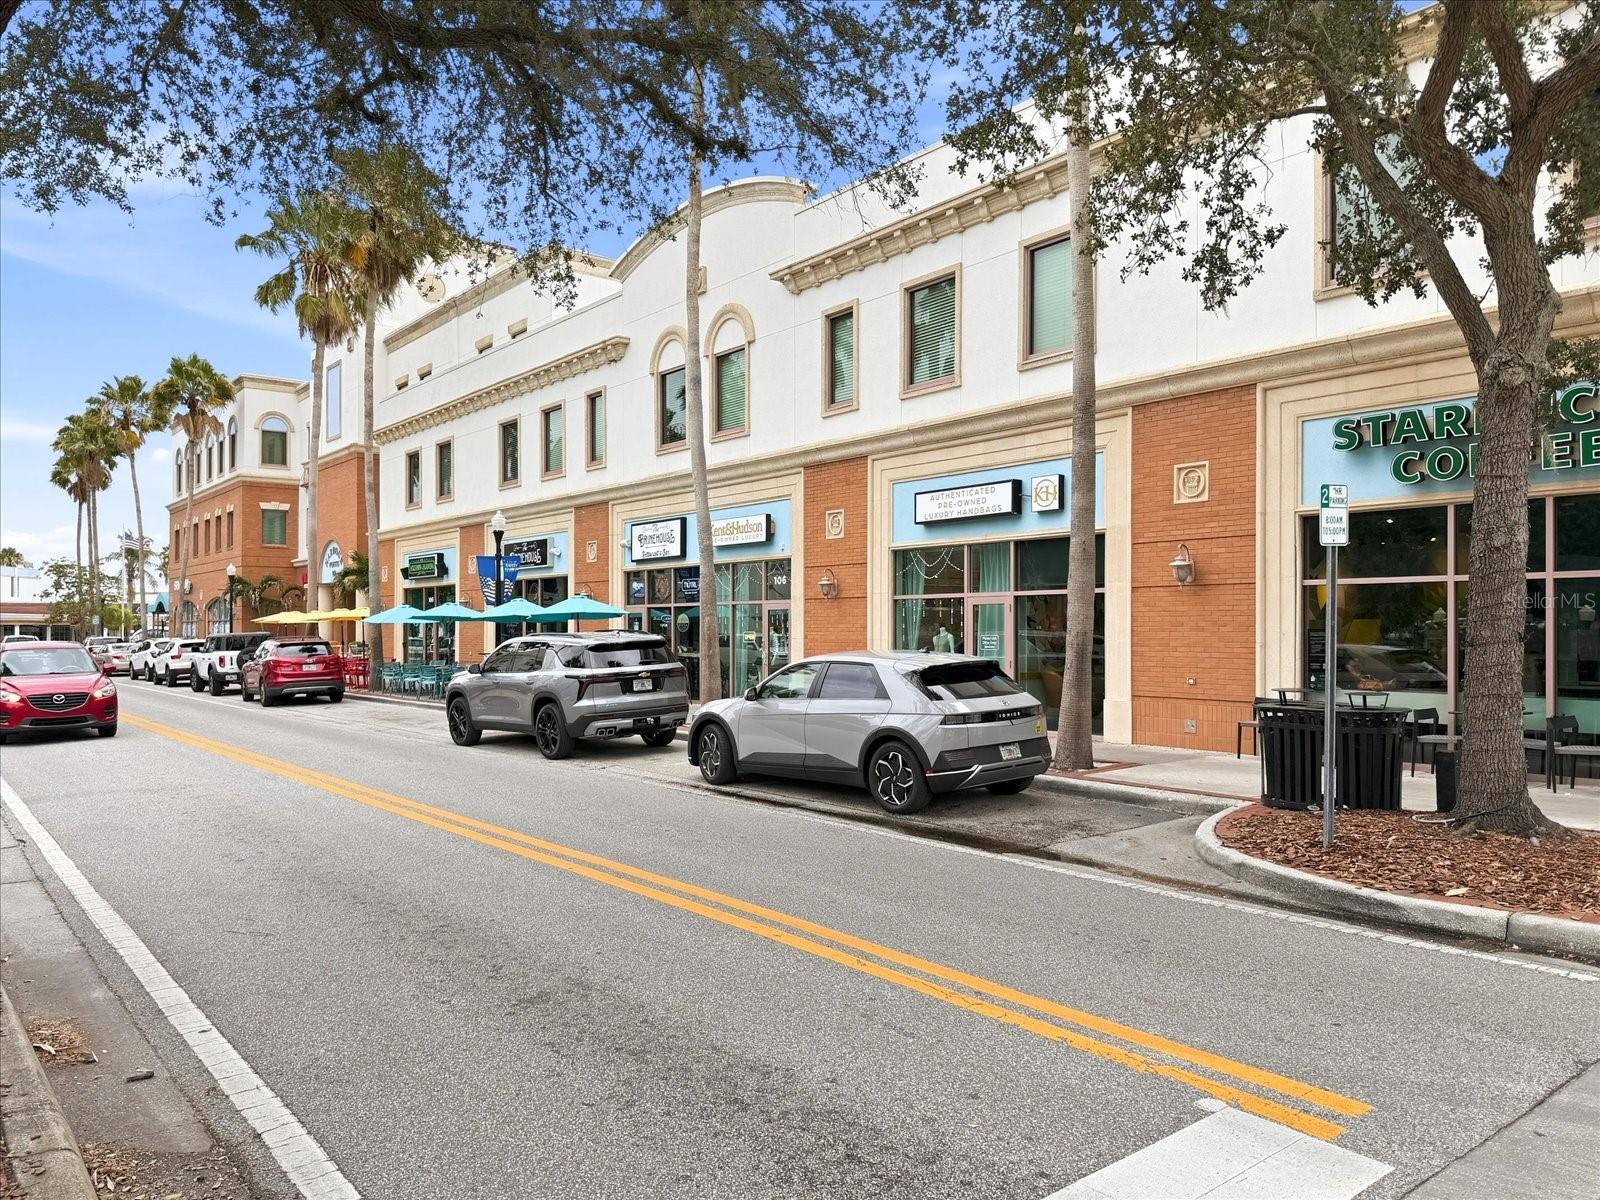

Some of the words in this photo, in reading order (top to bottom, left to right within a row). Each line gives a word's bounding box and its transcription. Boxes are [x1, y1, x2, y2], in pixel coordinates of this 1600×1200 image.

[930, 486, 996, 502] AUTHENTICATED
[1322, 489, 1329, 504] 2
[1329, 497, 1348, 505] PARKING
[937, 497, 987, 510] PRE-OWNED
[924, 510, 954, 521] LUXURY
[956, 504, 1003, 518] HANDBAGS
[711, 520, 763, 538] ent&Hudson
